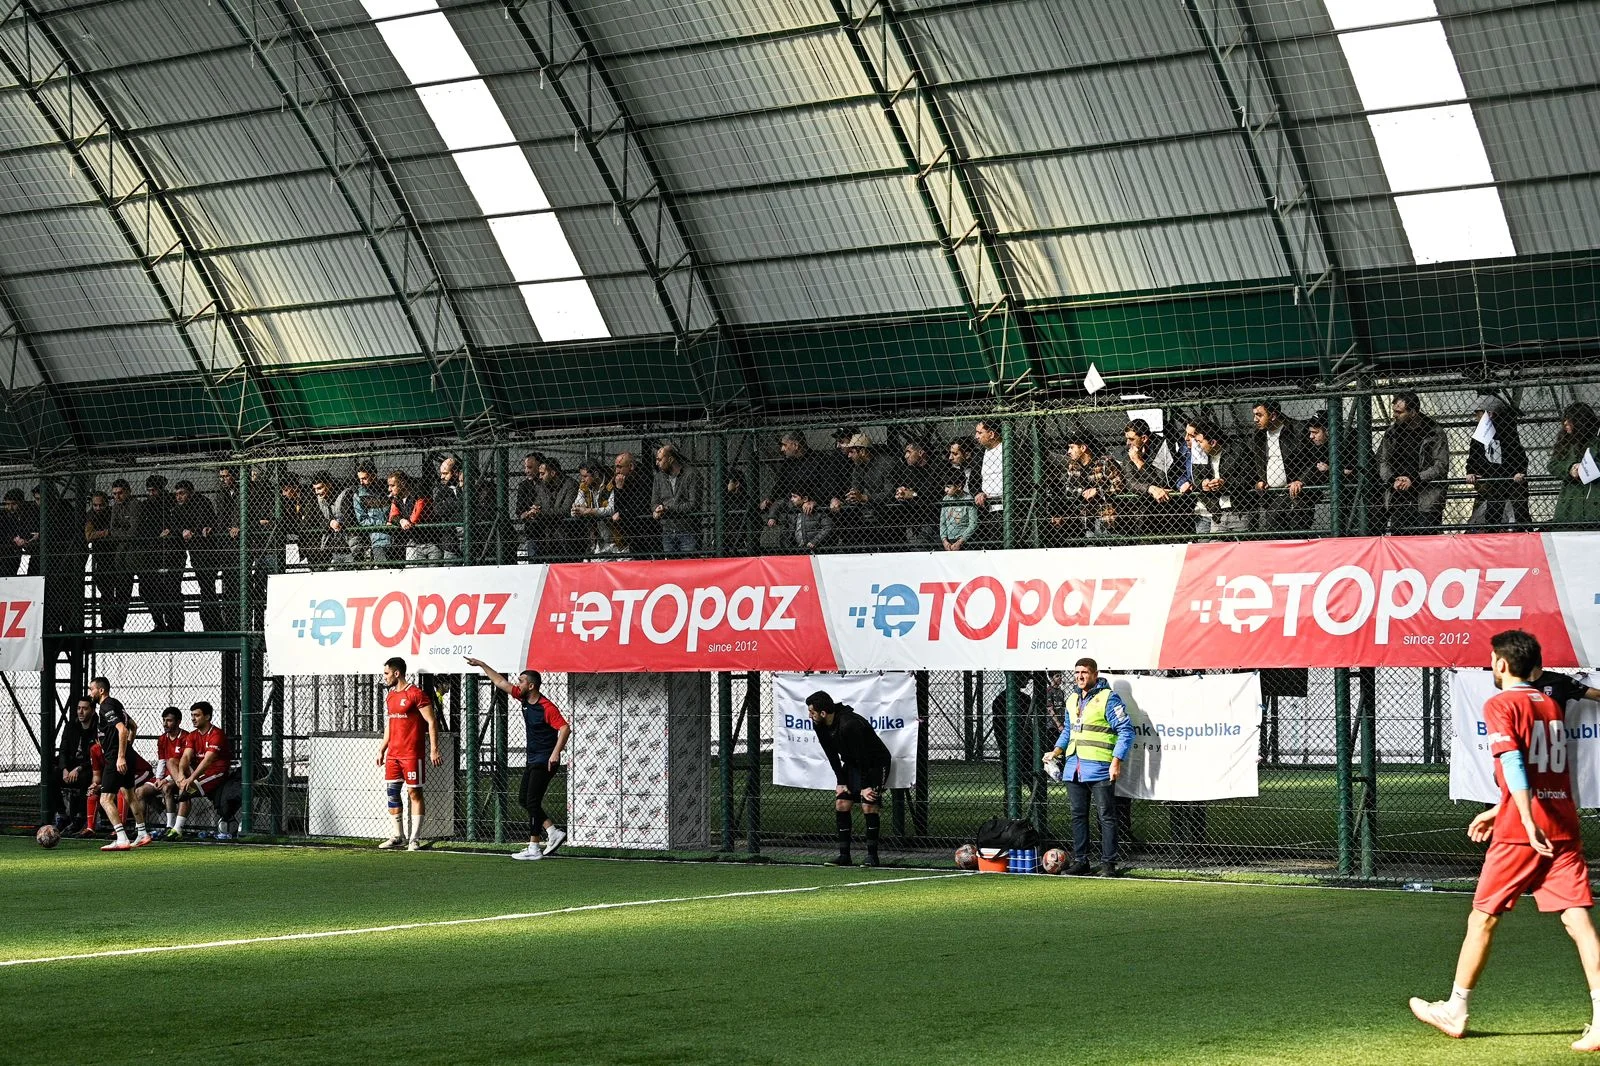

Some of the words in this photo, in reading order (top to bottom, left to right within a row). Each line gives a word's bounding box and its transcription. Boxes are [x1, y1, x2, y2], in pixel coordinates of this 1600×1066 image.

[1031, 639, 1058, 650] since
[1061, 639, 1088, 650] 2012
[1403, 634, 1435, 645] since
[1439, 632, 1470, 645] 2012
[429, 645, 450, 655] since
[453, 645, 473, 655] 2012
[708, 643, 732, 653] since
[735, 641, 757, 651] 2012
[785, 715, 813, 730] Ban
[870, 715, 905, 730] blika
[1156, 722, 1241, 740] Respublika
[1528, 719, 1568, 774] 48
[407, 771, 417, 780] 99
